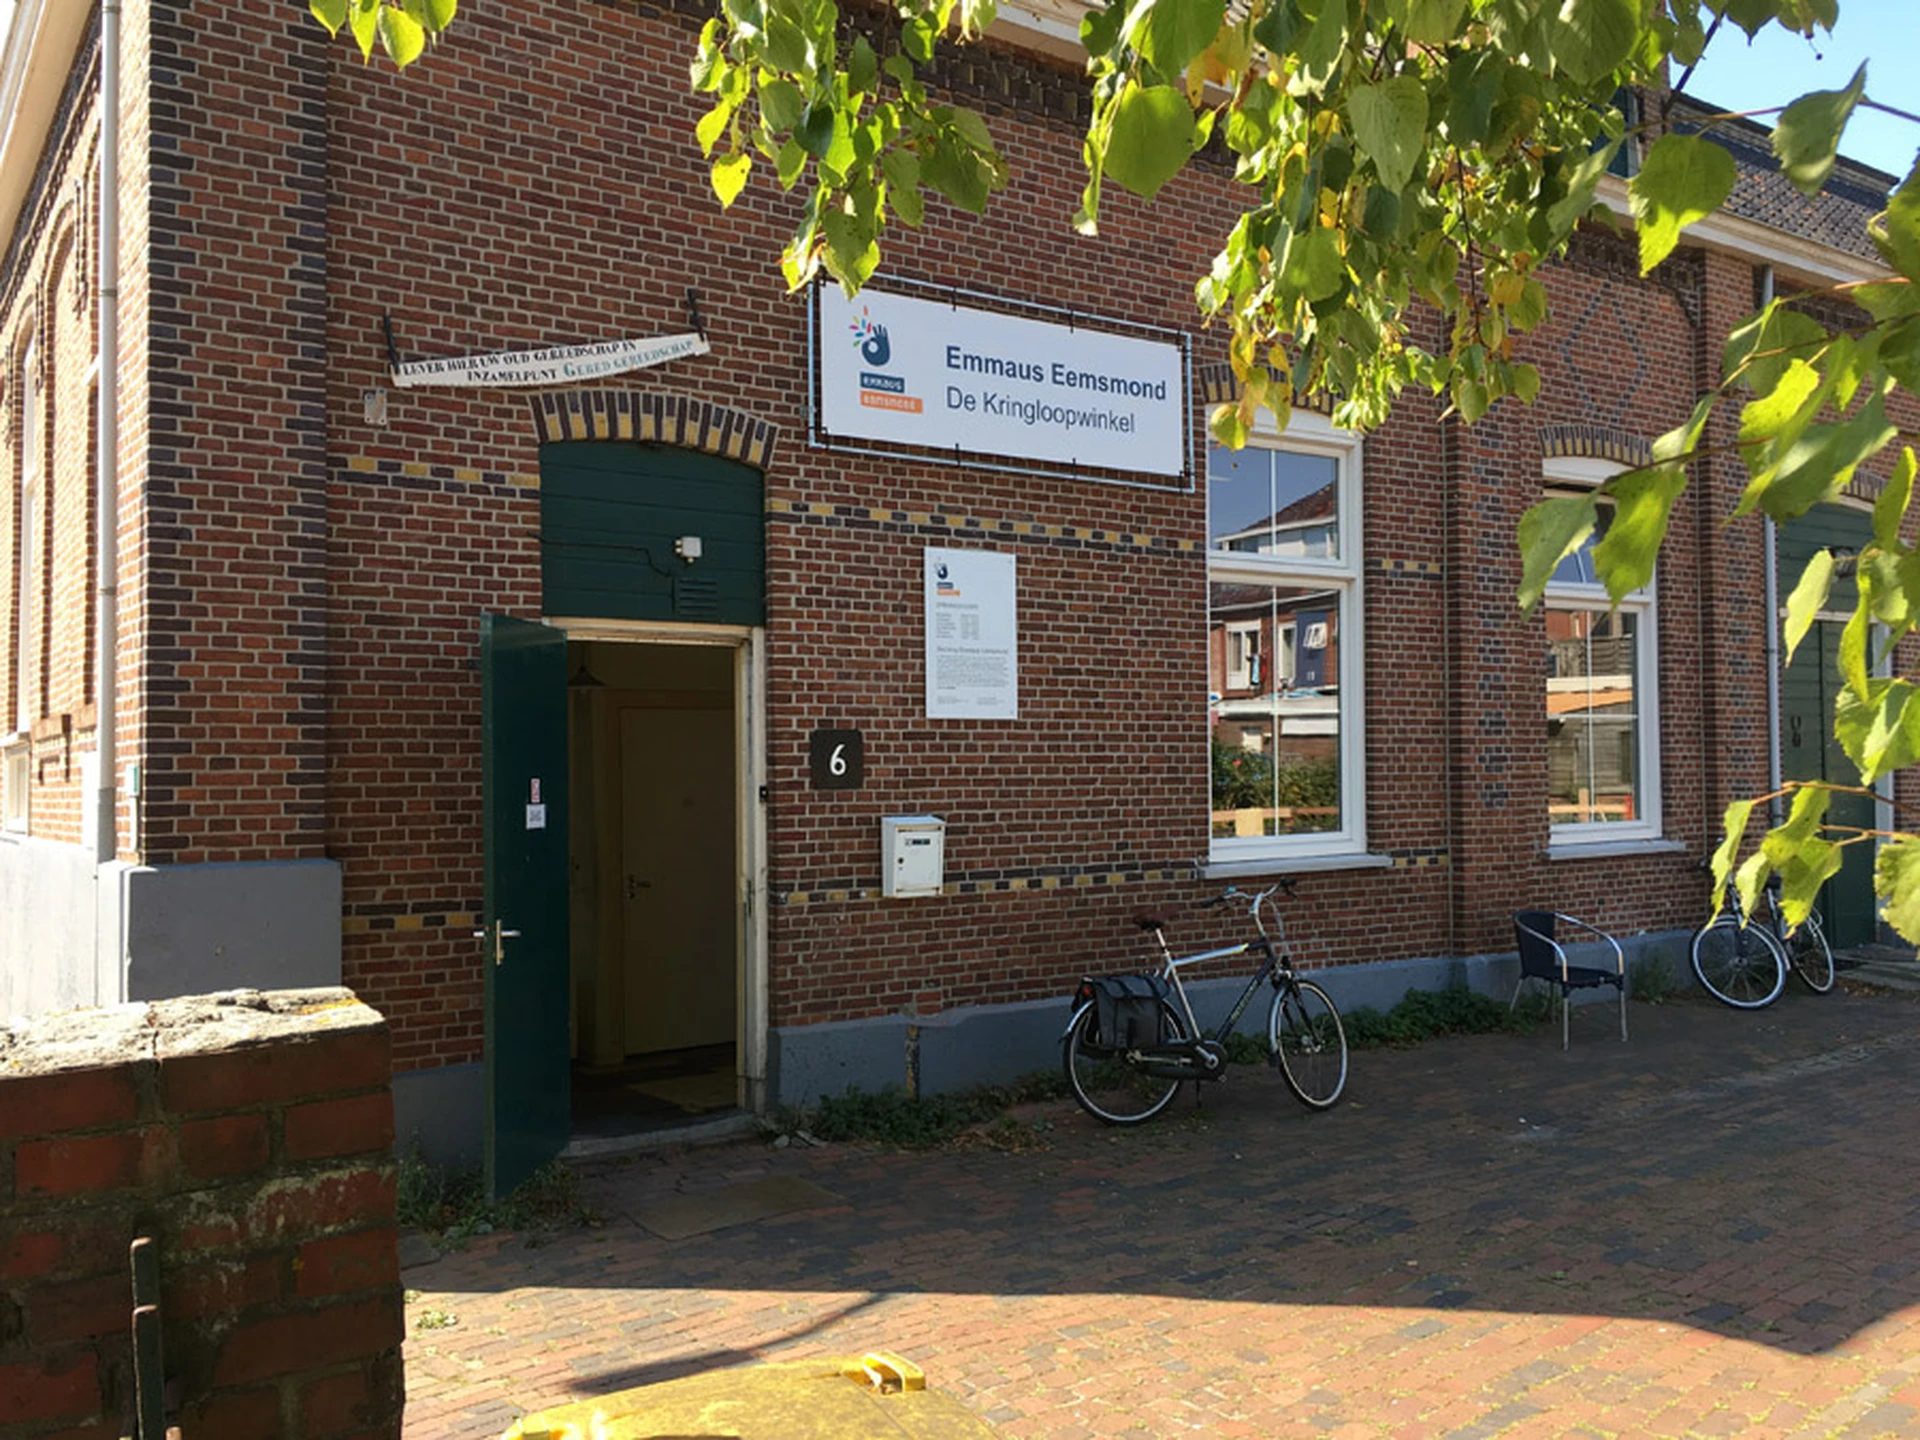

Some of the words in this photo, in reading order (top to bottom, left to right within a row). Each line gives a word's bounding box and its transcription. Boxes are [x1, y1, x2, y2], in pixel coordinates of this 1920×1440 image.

[403, 361, 444, 375] LEVER
[447, 358, 479, 371] HIER
[480, 356, 500, 367] UW
[503, 353, 530, 365] OUD
[534, 342, 619, 361] GEREEDSCHAP
[946, 345, 1044, 383] Emmaus
[1051, 362, 1166, 401] Eemsmond
[468, 369, 557, 382] INZAMELPUNT
[947, 386, 976, 412] De
[983, 391, 1135, 434] Kringloopwinkel
[829, 744, 847, 776] 6
